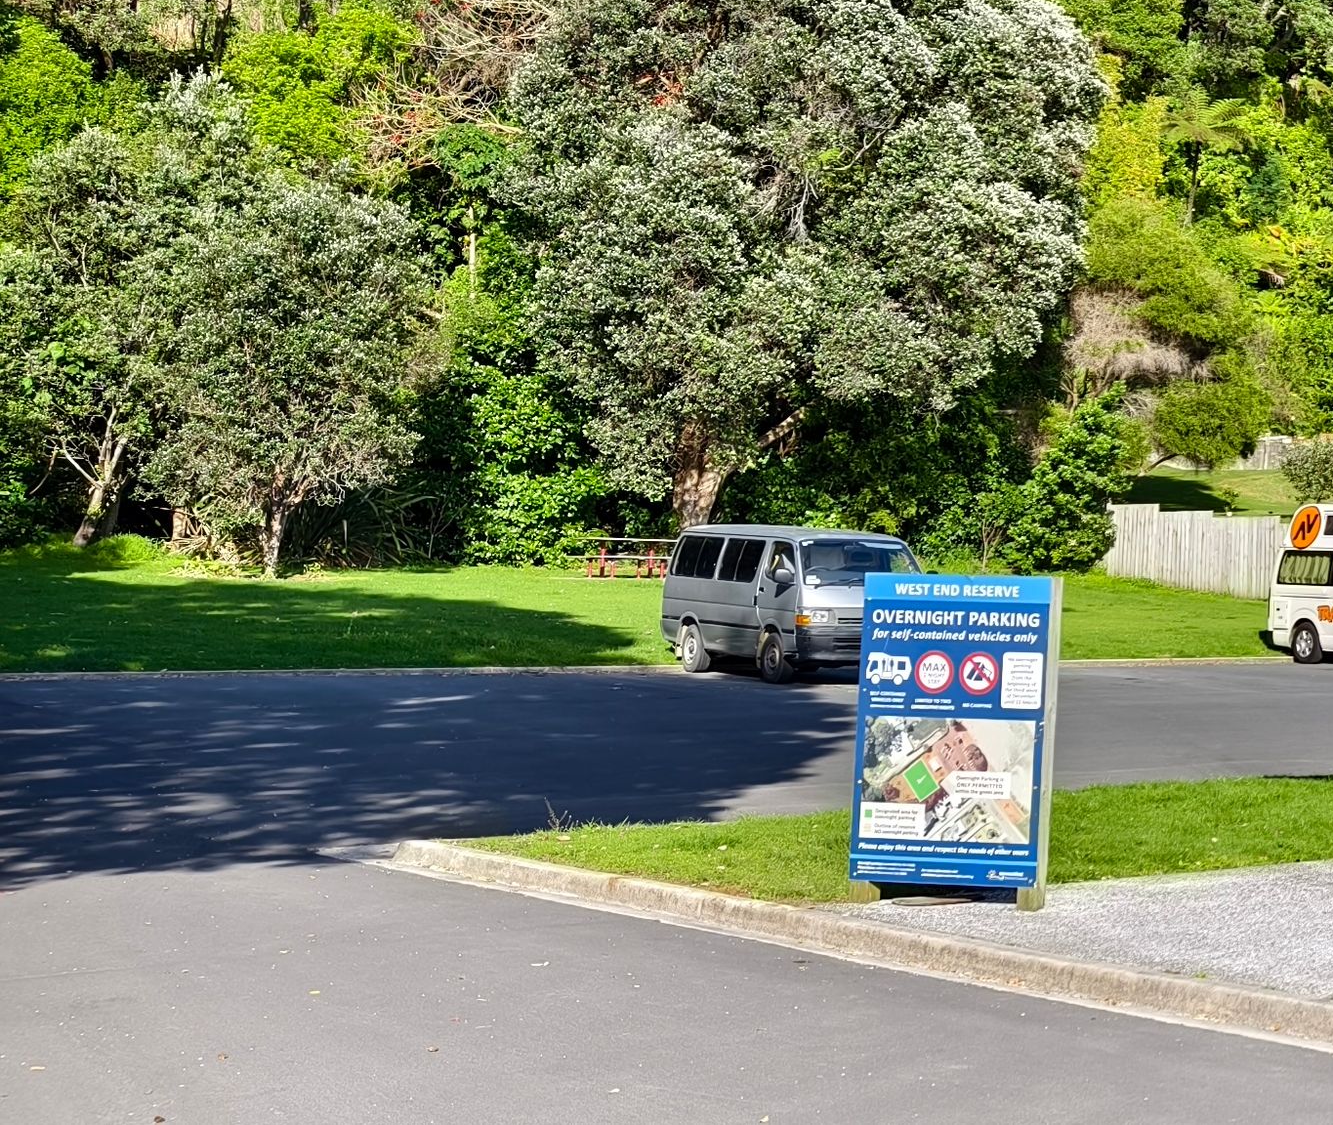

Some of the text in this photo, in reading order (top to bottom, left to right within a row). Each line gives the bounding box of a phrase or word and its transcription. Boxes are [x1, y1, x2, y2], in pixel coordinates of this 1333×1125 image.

[895, 583, 1020, 598] WEST END RESERVE
[872, 609, 1040, 627] OVERNIGHT PARKING
[872, 628, 1038, 645] for self-contained vehicles only
[922, 662, 946, 672] MAX
